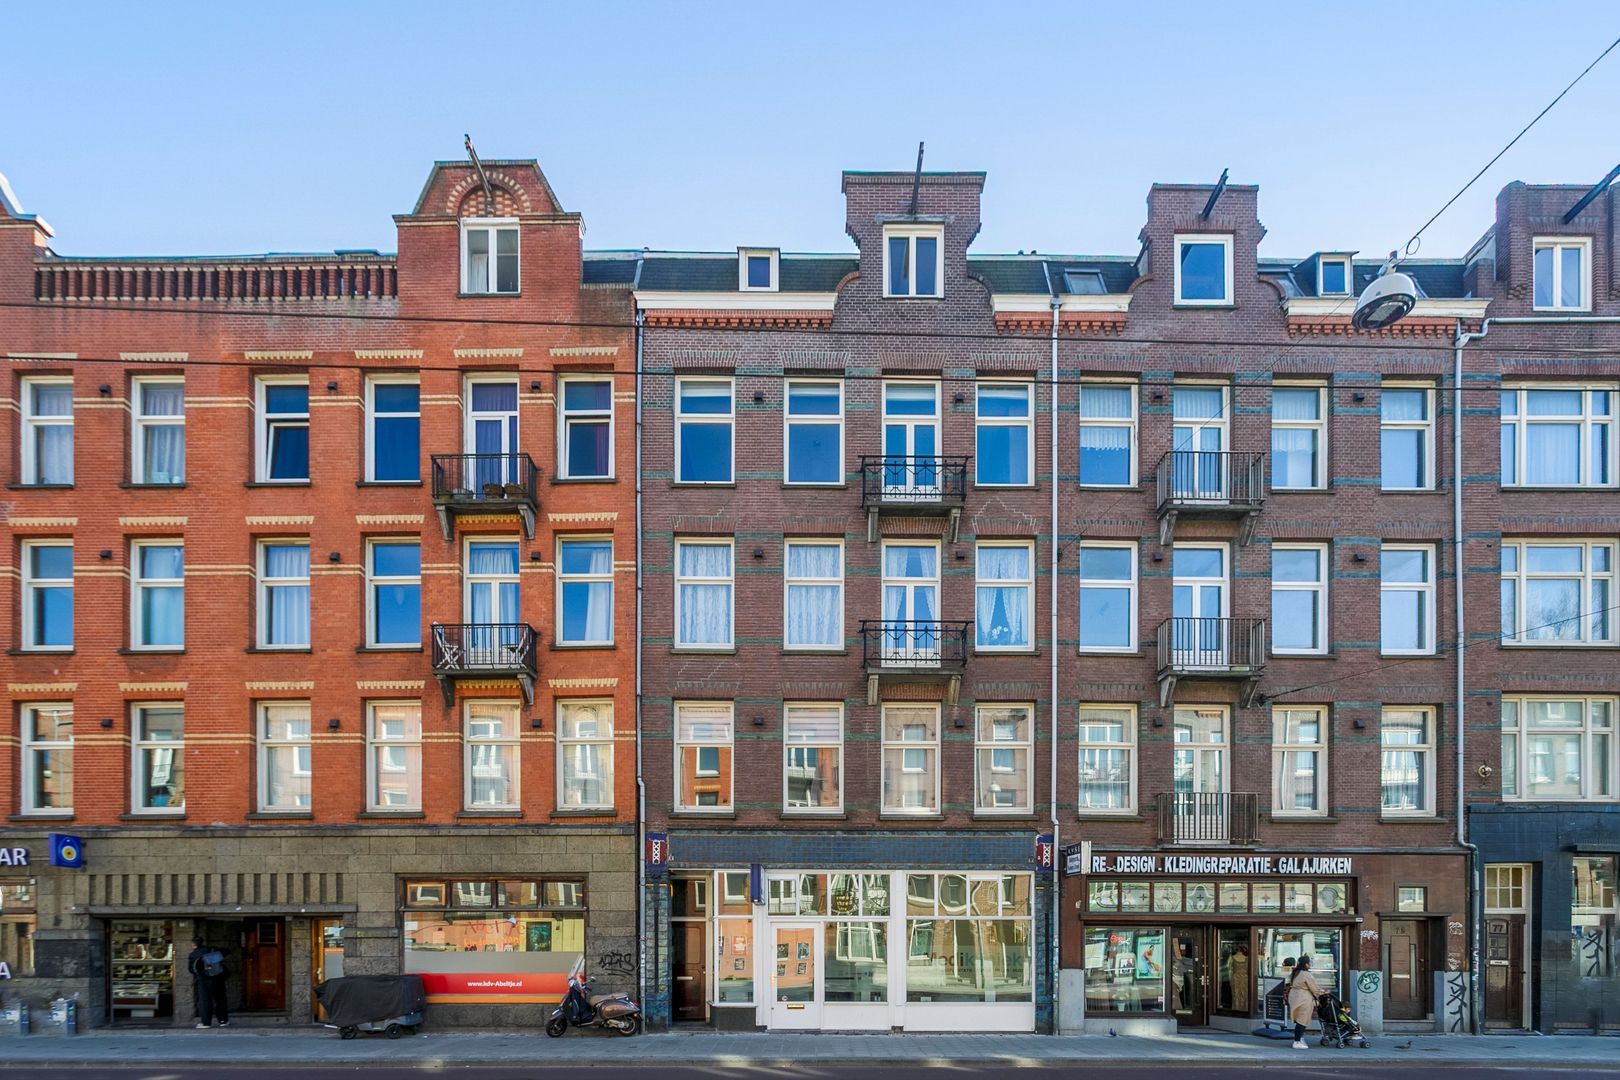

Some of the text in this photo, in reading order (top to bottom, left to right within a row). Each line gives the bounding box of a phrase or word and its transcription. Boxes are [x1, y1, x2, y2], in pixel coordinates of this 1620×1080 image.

[1092, 855, 1107, 873] RE
[1116, 855, 1156, 873] DESIGN
[1164, 856, 1271, 874] KLEDINGREPARATIE
[1493, 924, 1504, 932] 77
